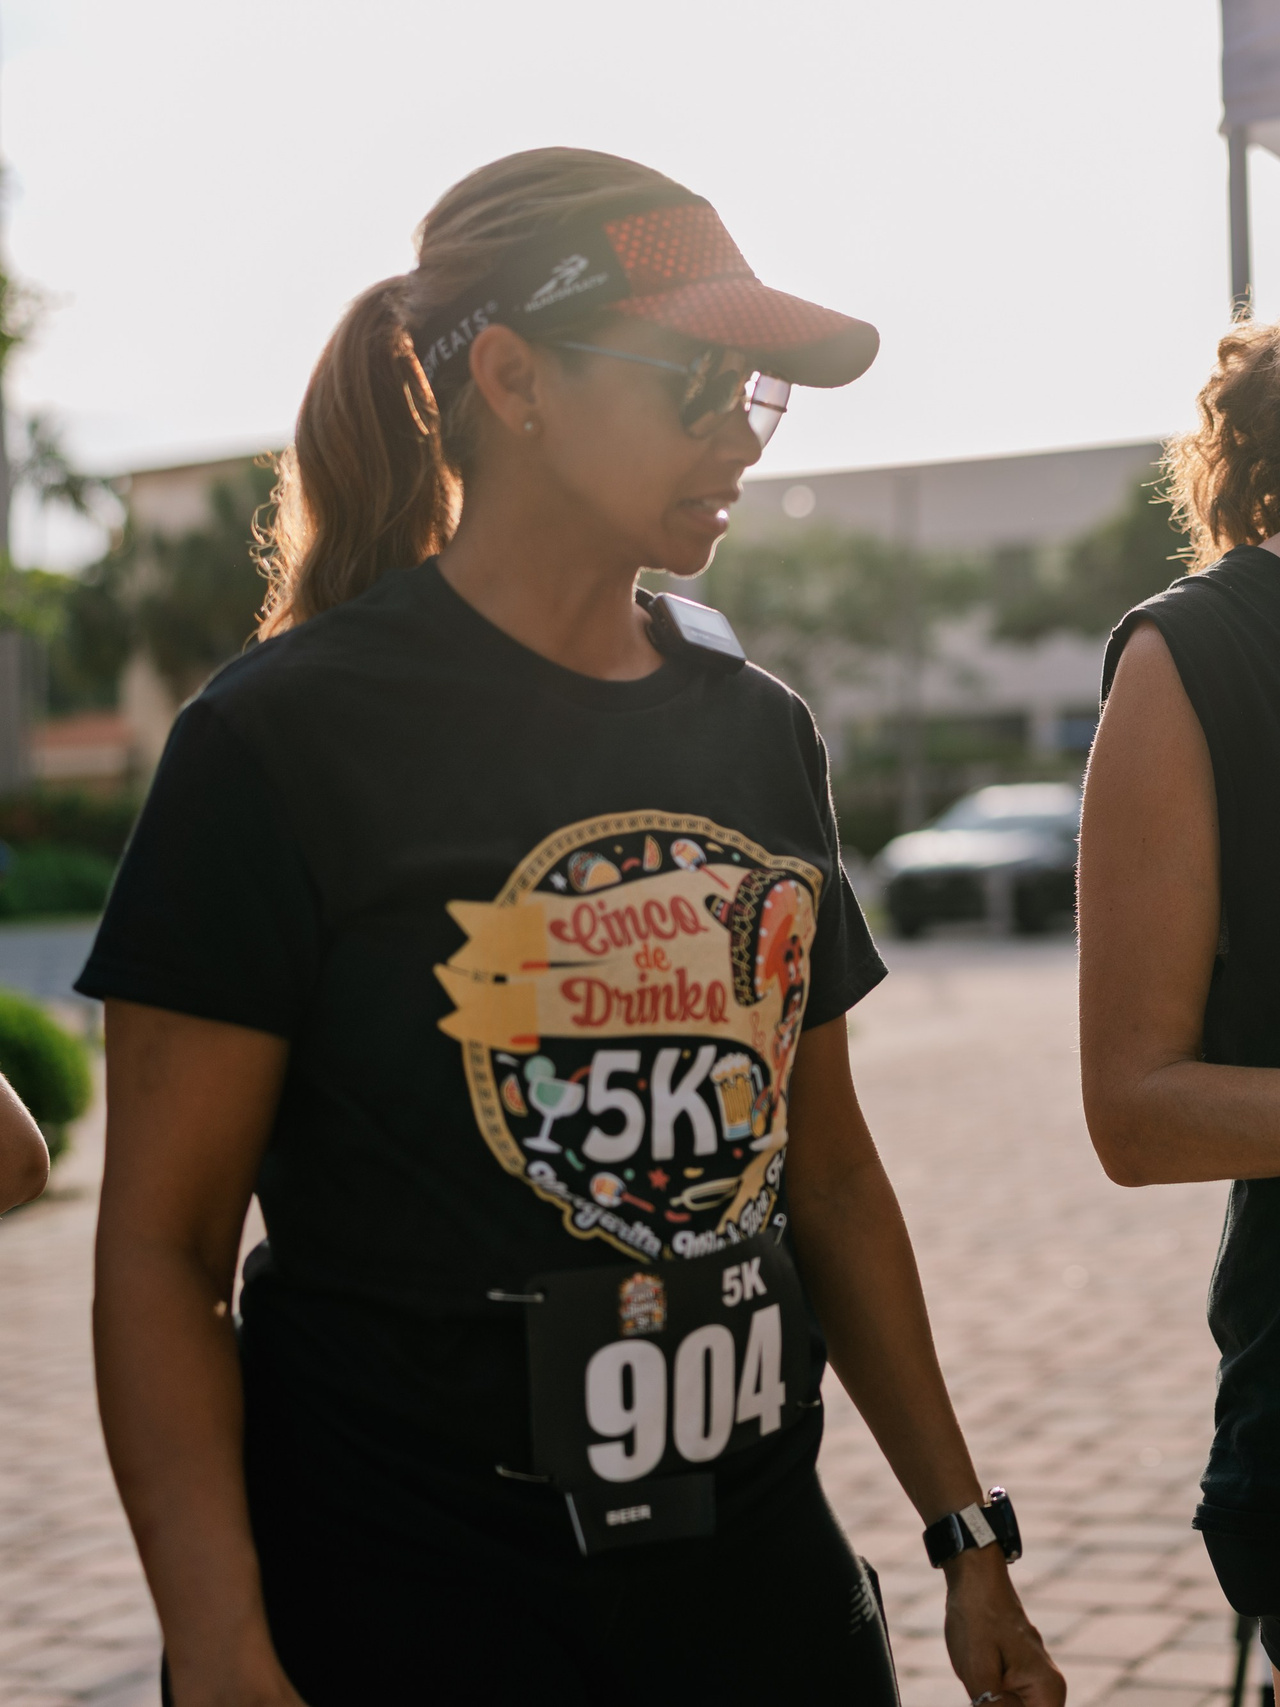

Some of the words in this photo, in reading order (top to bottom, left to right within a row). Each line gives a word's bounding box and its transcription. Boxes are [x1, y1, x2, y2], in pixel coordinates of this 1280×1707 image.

[549, 896, 710, 956] Cinco
[633, 944, 672, 973] de
[560, 968, 731, 1029] Drinko
[581, 1045, 717, 1164] 5K
[722, 1257, 767, 1307] 5K
[585, 1304, 785, 1482] 904
[606, 1505, 651, 1526] BEER
